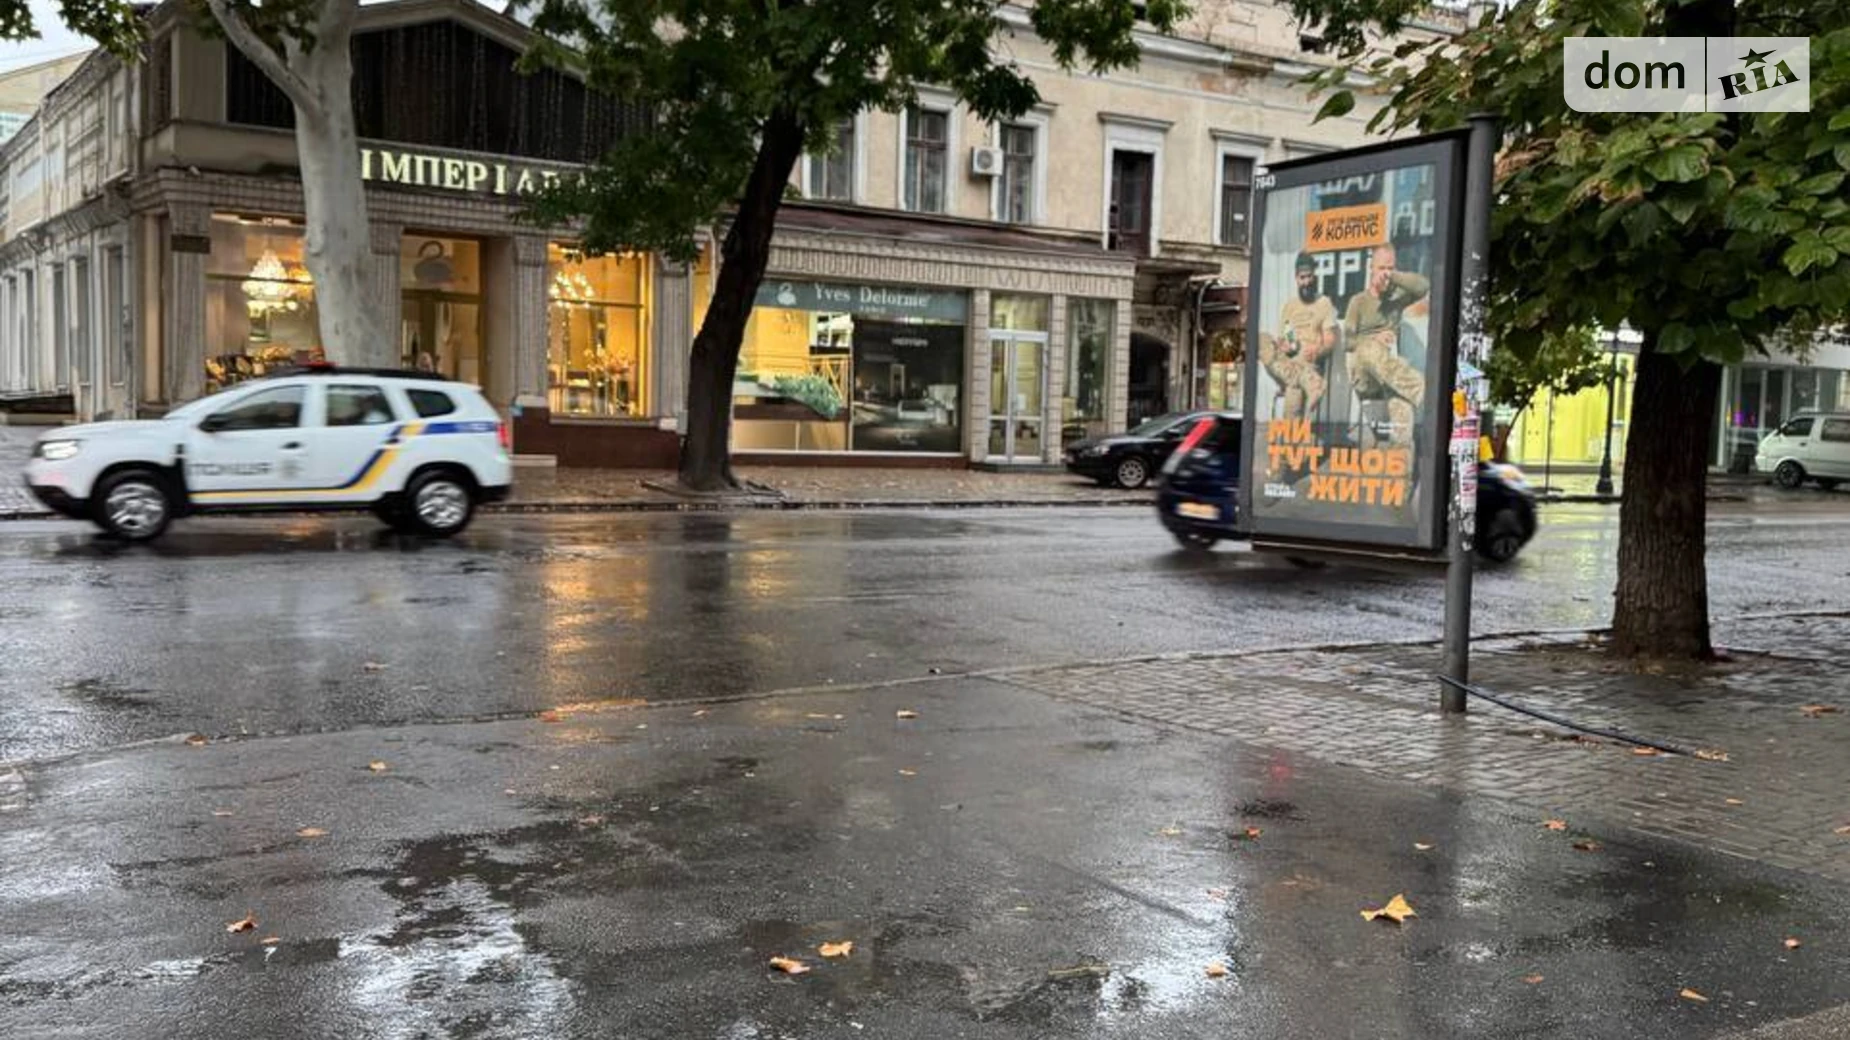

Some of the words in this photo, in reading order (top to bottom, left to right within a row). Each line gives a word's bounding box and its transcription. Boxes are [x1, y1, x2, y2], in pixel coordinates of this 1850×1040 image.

[814, 282, 850, 302] Yves
[859, 287, 929, 308] Delorme
[1268, 418, 1311, 445] МИ
[1268, 445, 1324, 474] ТУТ
[1330, 447, 1407, 476] ЩОБ
[1307, 474, 1405, 505] ЖИТИ
